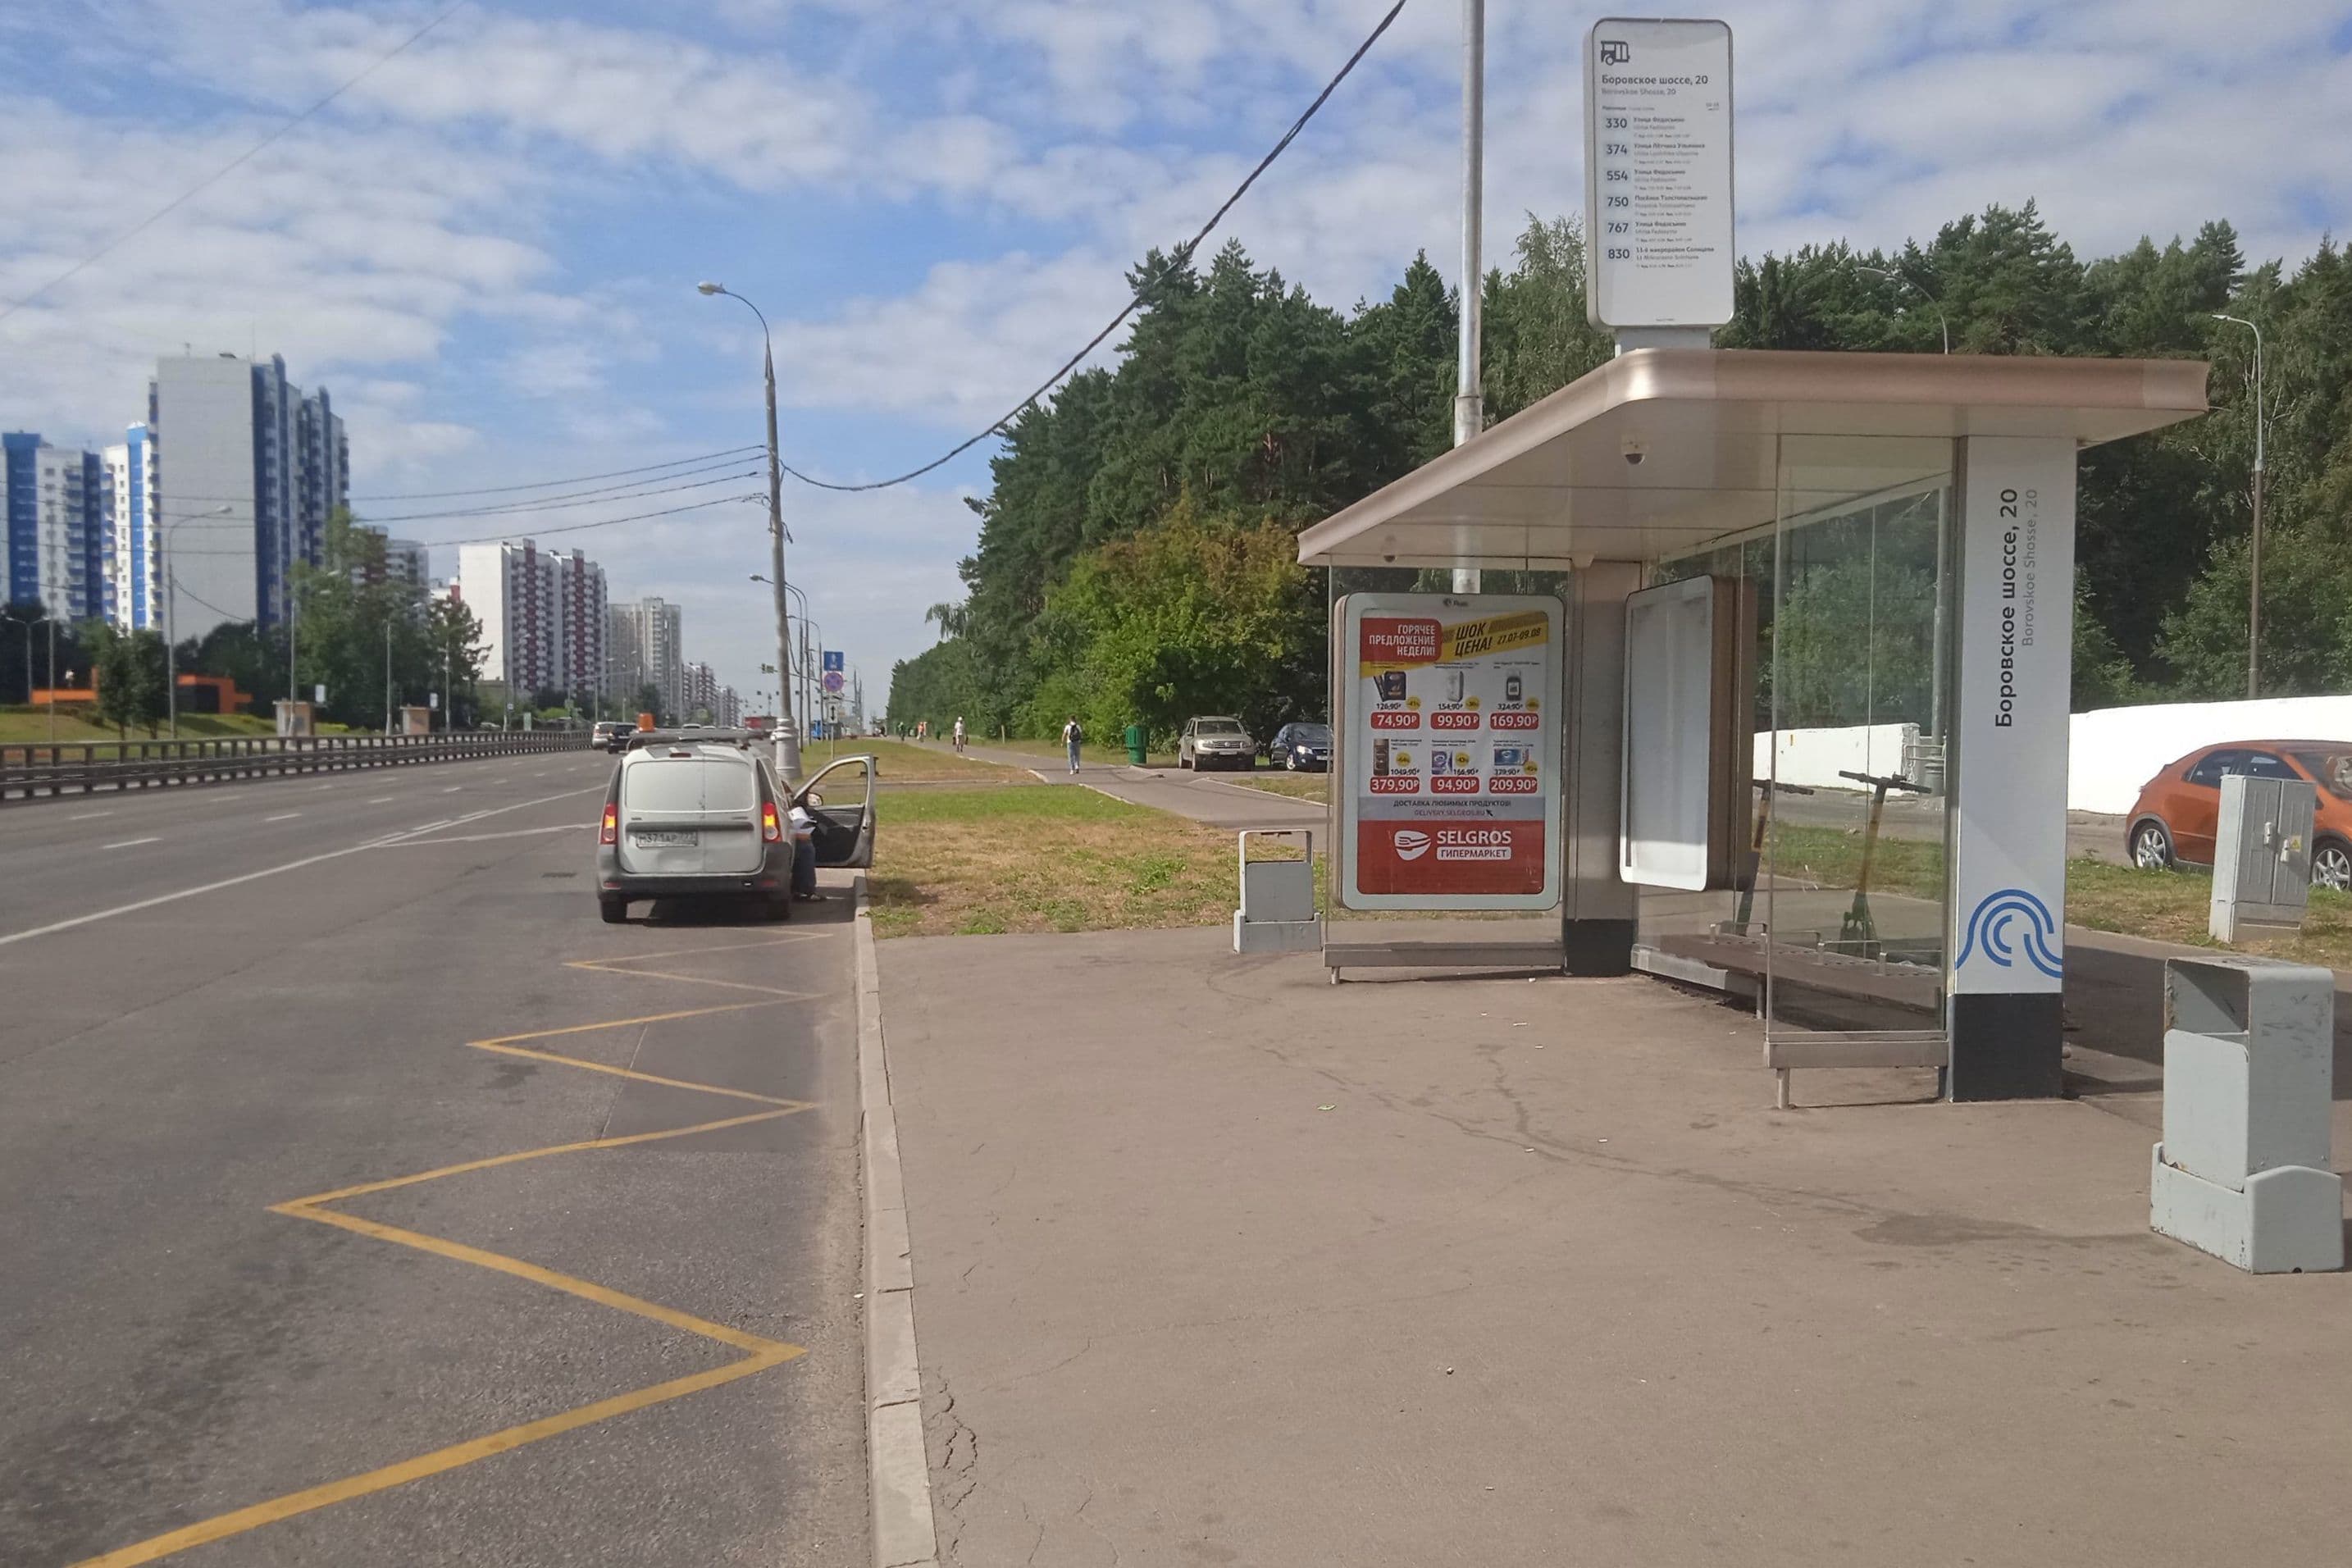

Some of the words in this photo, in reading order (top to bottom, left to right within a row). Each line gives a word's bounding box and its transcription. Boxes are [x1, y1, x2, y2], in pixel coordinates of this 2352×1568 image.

[1602, 75, 1657, 85] Боровское
[1659, 77, 1693, 85] шоссе,
[1695, 75, 1708, 84] 20
[1607, 118, 1627, 129] 330
[1607, 144, 1627, 155] 374
[1607, 171, 1628, 181] 554
[1607, 197, 1629, 207] 750
[1608, 223, 1629, 233] 767
[1608, 249, 1630, 259] 830
[2000, 489, 2017, 517] 20
[2026, 489, 2037, 508] 20
[2024, 513, 2039, 567] Shosse,
[2003, 526, 2020, 599] шоссе,
[2022, 572, 2035, 646] Borovskoe
[1397, 624, 1435, 635] ГОРЯЧЕЕ
[1456, 622, 1487, 640] ШОК
[1369, 635, 1435, 646] ПРЕДЛОЖЕНИЕ
[1497, 627, 1542, 645] 27.07-09.08
[1397, 646, 1435, 657] НЕДЕЛИ!
[1455, 636, 1493, 657] ЦЕНА!
[1995, 607, 2017, 727] Боровское
[1437, 830, 1511, 844] SELGROS
[1441, 849, 1506, 858] ГИПЕРМАРКЕТ
